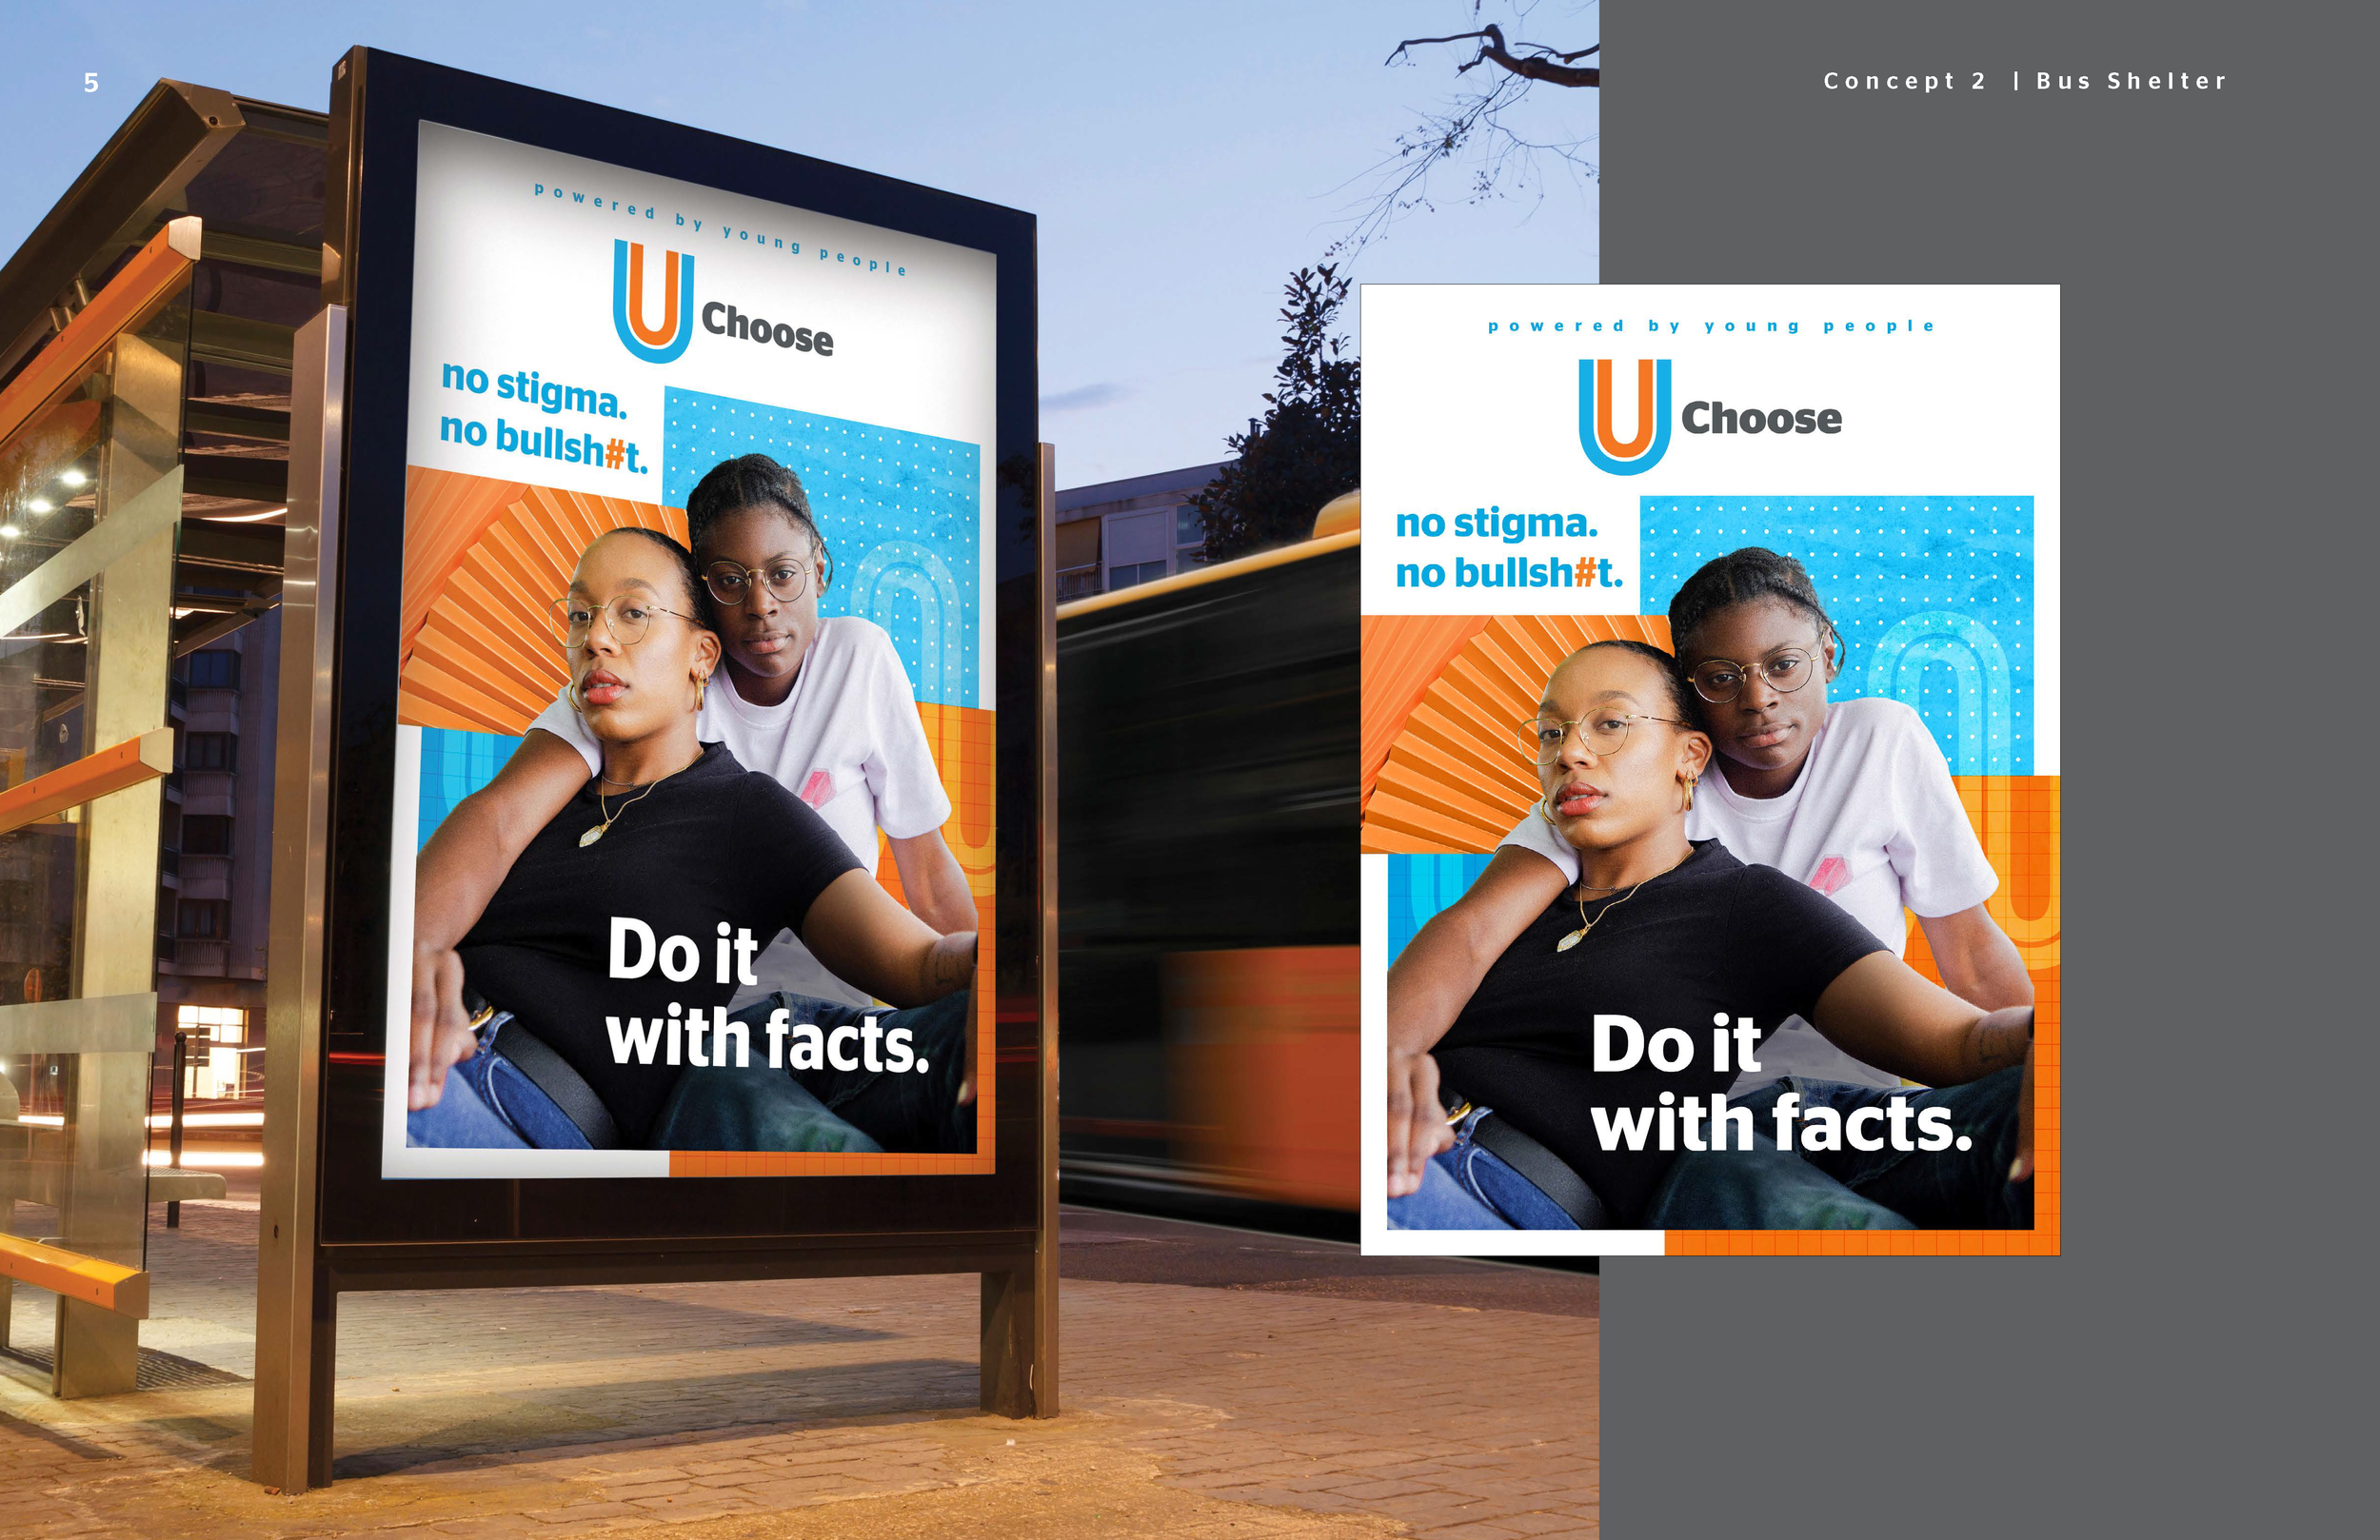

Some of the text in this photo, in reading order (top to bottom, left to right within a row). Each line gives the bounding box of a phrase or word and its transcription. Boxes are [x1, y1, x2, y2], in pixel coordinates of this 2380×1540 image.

[534, 182, 907, 277] powered by young people
[702, 300, 835, 357] Choose
[1488, 319, 1935, 336] powered by young people
[442, 362, 627, 421] no stigma.
[1681, 401, 1843, 435] Choose
[440, 415, 648, 475] no bullsh#t.
[1397, 504, 1599, 545] no stigma.
[1397, 556, 1624, 589] no bullsh#t.
[609, 917, 759, 987] Do it
[605, 1001, 930, 1076] with facts.
[1594, 1012, 1762, 1073] Do it
[1590, 1091, 1973, 1152] with facts.
